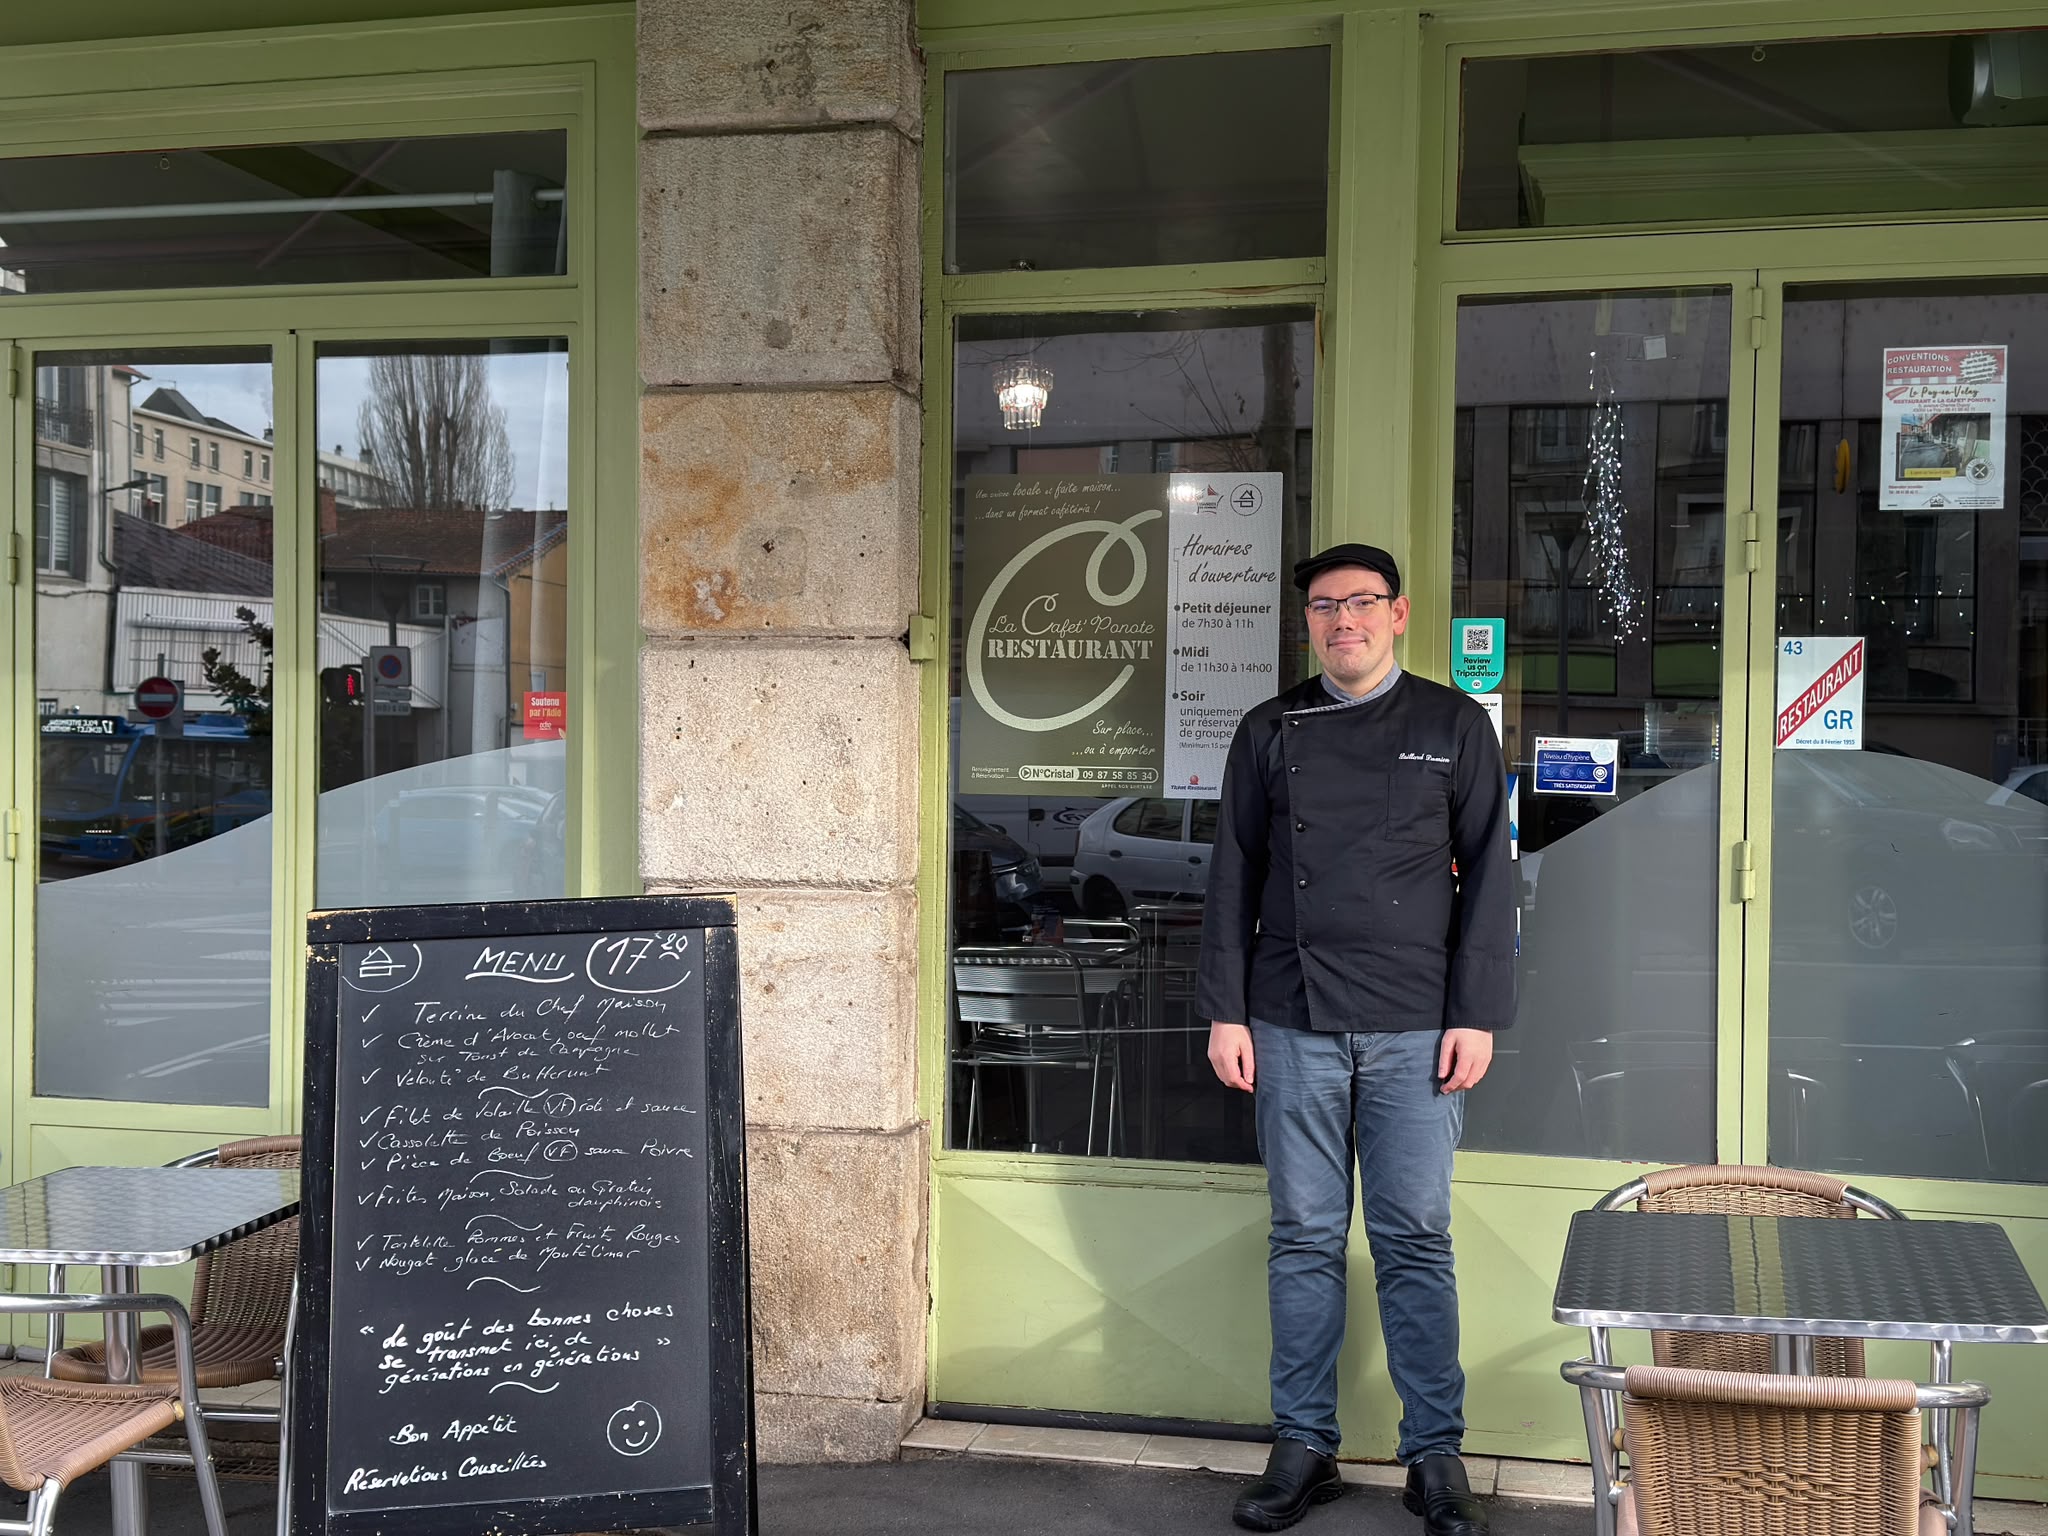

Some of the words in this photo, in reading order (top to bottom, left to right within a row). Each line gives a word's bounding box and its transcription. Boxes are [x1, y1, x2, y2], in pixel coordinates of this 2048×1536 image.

[1887, 352, 1950, 365] CONVENTIONS
[1887, 365, 1952, 374] RESTAURATION
[1012, 481, 1042, 498] locale
[1054, 480, 1078, 499] faite
[1006, 509, 1016, 518] un
[1018, 505, 1049, 521] format
[1050, 502, 1091, 519] cafétéria
[1182, 533, 1253, 557] Horaires
[1188, 561, 1277, 583] d'ouverture
[1182, 602, 1212, 614] Petit
[1214, 602, 1272, 617] déjeuner
[988, 615, 1018, 634] La
[1090, 615, 1156, 634] Ponote
[1181, 618, 1195, 629] de
[1197, 618, 1224, 629] 7h30
[1225, 618, 1232, 629] à
[1235, 618, 1254, 629] 11h
[987, 639, 1153, 660] RESTAURANT
[1181, 646, 1209, 658] Midi
[1783, 641, 1803, 655] 43
[1180, 662, 1194, 673] de
[1197, 662, 1229, 673] 11h30
[1231, 662, 1237, 673] à
[1240, 662, 1273, 673] 14h00
[1455, 670, 1499, 678] Tripadvisor
[530, 697, 560, 706] Soutenu
[1180, 690, 1206, 701] Soir
[1779, 647, 1860, 740] RESTAURANT
[529, 709, 541, 718] par
[1179, 718, 1195, 727] sur
[1180, 707, 1244, 719] uniquement
[1823, 709, 1854, 730] GR
[1092, 719, 1112, 735] Sur
[1113, 720, 1154, 740] place...
[1179, 728, 1193, 738] de
[1195, 729, 1233, 740] groupe
[1099, 743, 1106, 755] à
[1108, 744, 1157, 760] emporter
[1543, 752, 1563, 760] Niveau
[1563, 752, 1590, 762] d'hygiène
[1032, 768, 1075, 779] N°Cristal
[1082, 770, 1094, 780] 09
[1097, 770, 1108, 780] 87
[1112, 771, 1123, 780] 58
[1126, 771, 1138, 780] 85
[473, 947, 566, 974] MENU
[414, 1001, 487, 1024] Terrine
[500, 1003, 525, 1018] du
[536, 994, 585, 1024] Chef
[596, 996, 666, 1024] Maison
[398, 1032, 456, 1049] Crème
[614, 1022, 681, 1039] mollet
[458, 1047, 509, 1062] Toast
[517, 1046, 541, 1057] de
[549, 1037, 641, 1062] Campagne
[396, 1068, 462, 1088] Velouté
[466, 1070, 487, 1082] de
[384, 1104, 432, 1129] Filet
[442, 1107, 465, 1121] de
[475, 1099, 542, 1119] Volaille
[640, 1100, 697, 1115] sauce
[377, 1129, 473, 1150] Cassolette
[480, 1129, 503, 1140] de
[515, 1120, 580, 1138] Poisson
[386, 1152, 440, 1172] Pièce
[450, 1152, 473, 1166] de
[584, 1147, 630, 1156] sauce
[640, 1138, 694, 1159] Poivre
[499, 1181, 559, 1197] Salade
[567, 1185, 586, 1195] ou
[591, 1177, 653, 1196] Gratin
[567, 1195, 662, 1213] dauphinois
[382, 1234, 456, 1251] Tartelette
[467, 1229, 526, 1244] Pommes
[535, 1228, 559, 1242] et
[625, 1223, 681, 1249] Rouges
[379, 1251, 439, 1276] Nougat
[443, 1247, 503, 1273] glacé
[508, 1248, 528, 1260] de
[415, 1317, 473, 1354] goût
[482, 1319, 515, 1336] des
[526, 1307, 592, 1327] bonnes
[606, 1301, 675, 1322] choses
[378, 1354, 407, 1370] se
[426, 1337, 513, 1363] transmet
[564, 1331, 593, 1346] de
[378, 1361, 491, 1394] générations
[503, 1362, 523, 1373] en
[530, 1344, 641, 1378] générations
[389, 1424, 429, 1445] Bon
[441, 1413, 518, 1443] Appétit
[343, 1464, 449, 1495] Réservations
[458, 1451, 548, 1478] Conseillées
